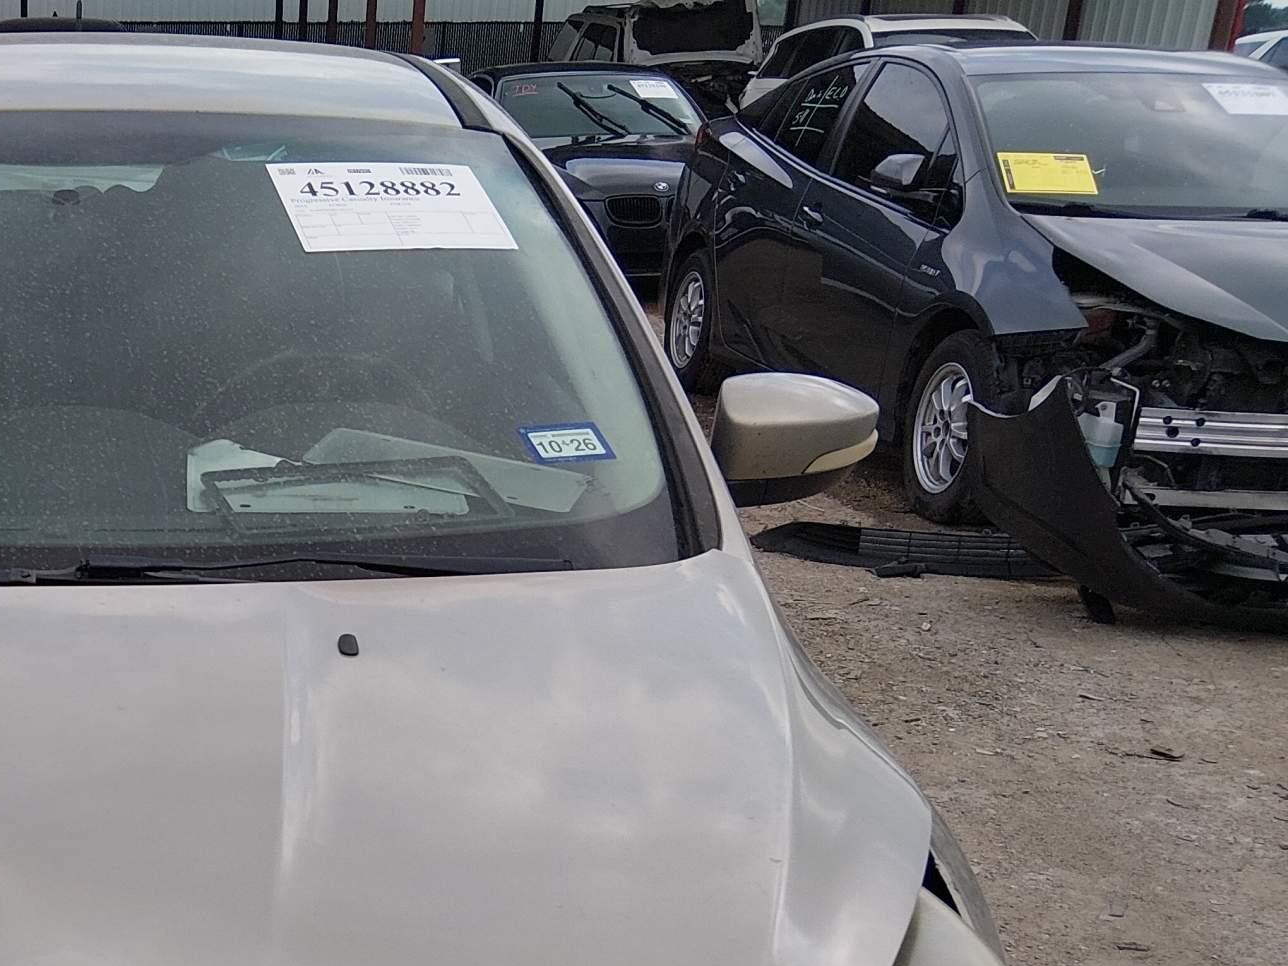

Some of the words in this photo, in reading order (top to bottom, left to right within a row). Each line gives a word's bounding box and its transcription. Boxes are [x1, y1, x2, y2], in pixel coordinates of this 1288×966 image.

[299, 181, 461, 197] 45128882
[536, 440, 563, 454] 10
[570, 438, 597, 452] 26
